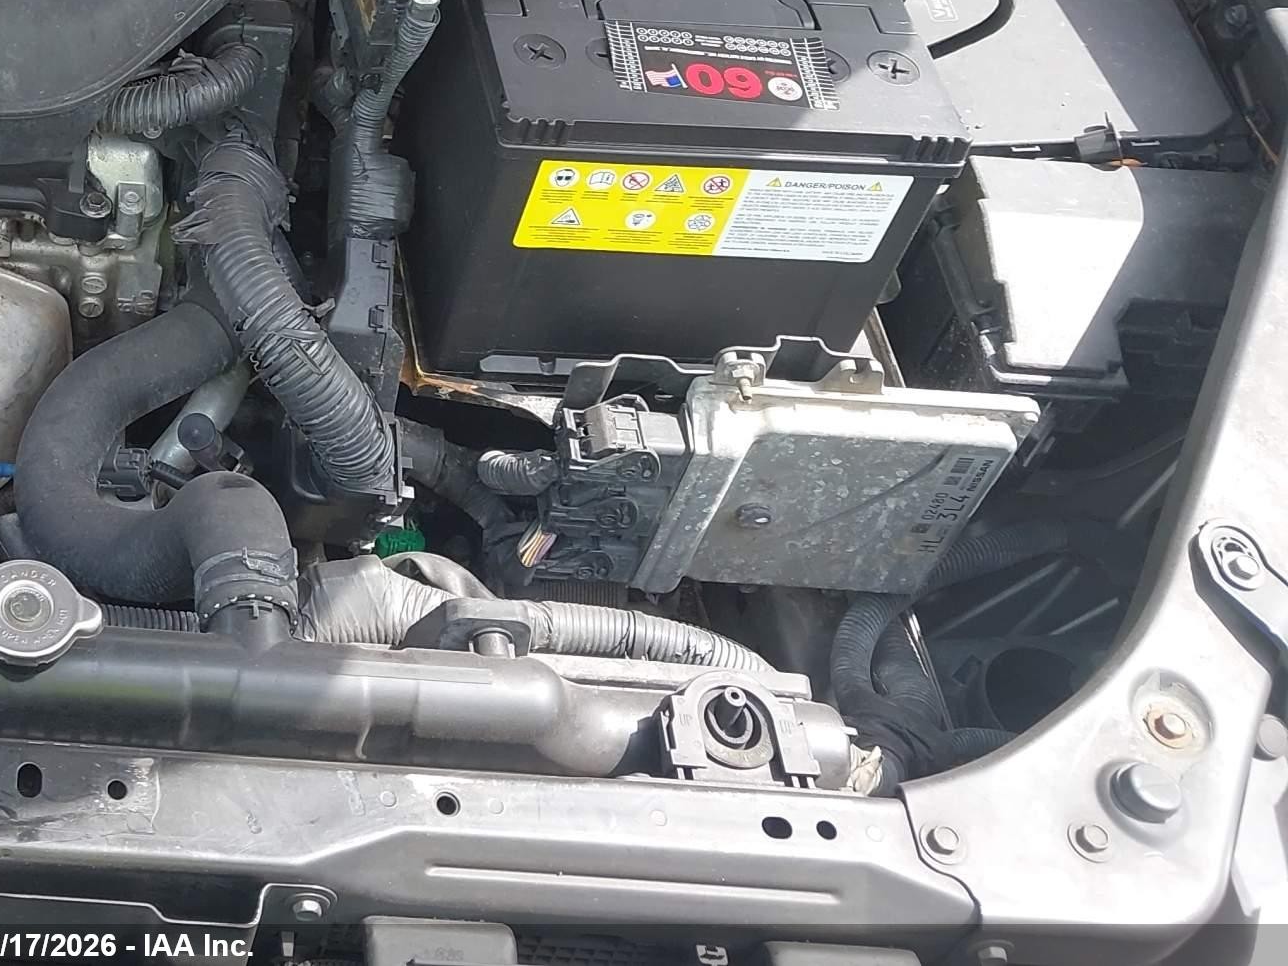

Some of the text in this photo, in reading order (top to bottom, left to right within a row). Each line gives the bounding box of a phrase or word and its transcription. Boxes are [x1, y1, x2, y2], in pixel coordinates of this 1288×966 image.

[686, 63, 763, 99] 60
[784, 180, 866, 192] DANGER/POISON
[966, 459, 995, 492] NISSAN
[920, 492, 949, 521] 02480
[0, 570, 57, 587] DANGER
